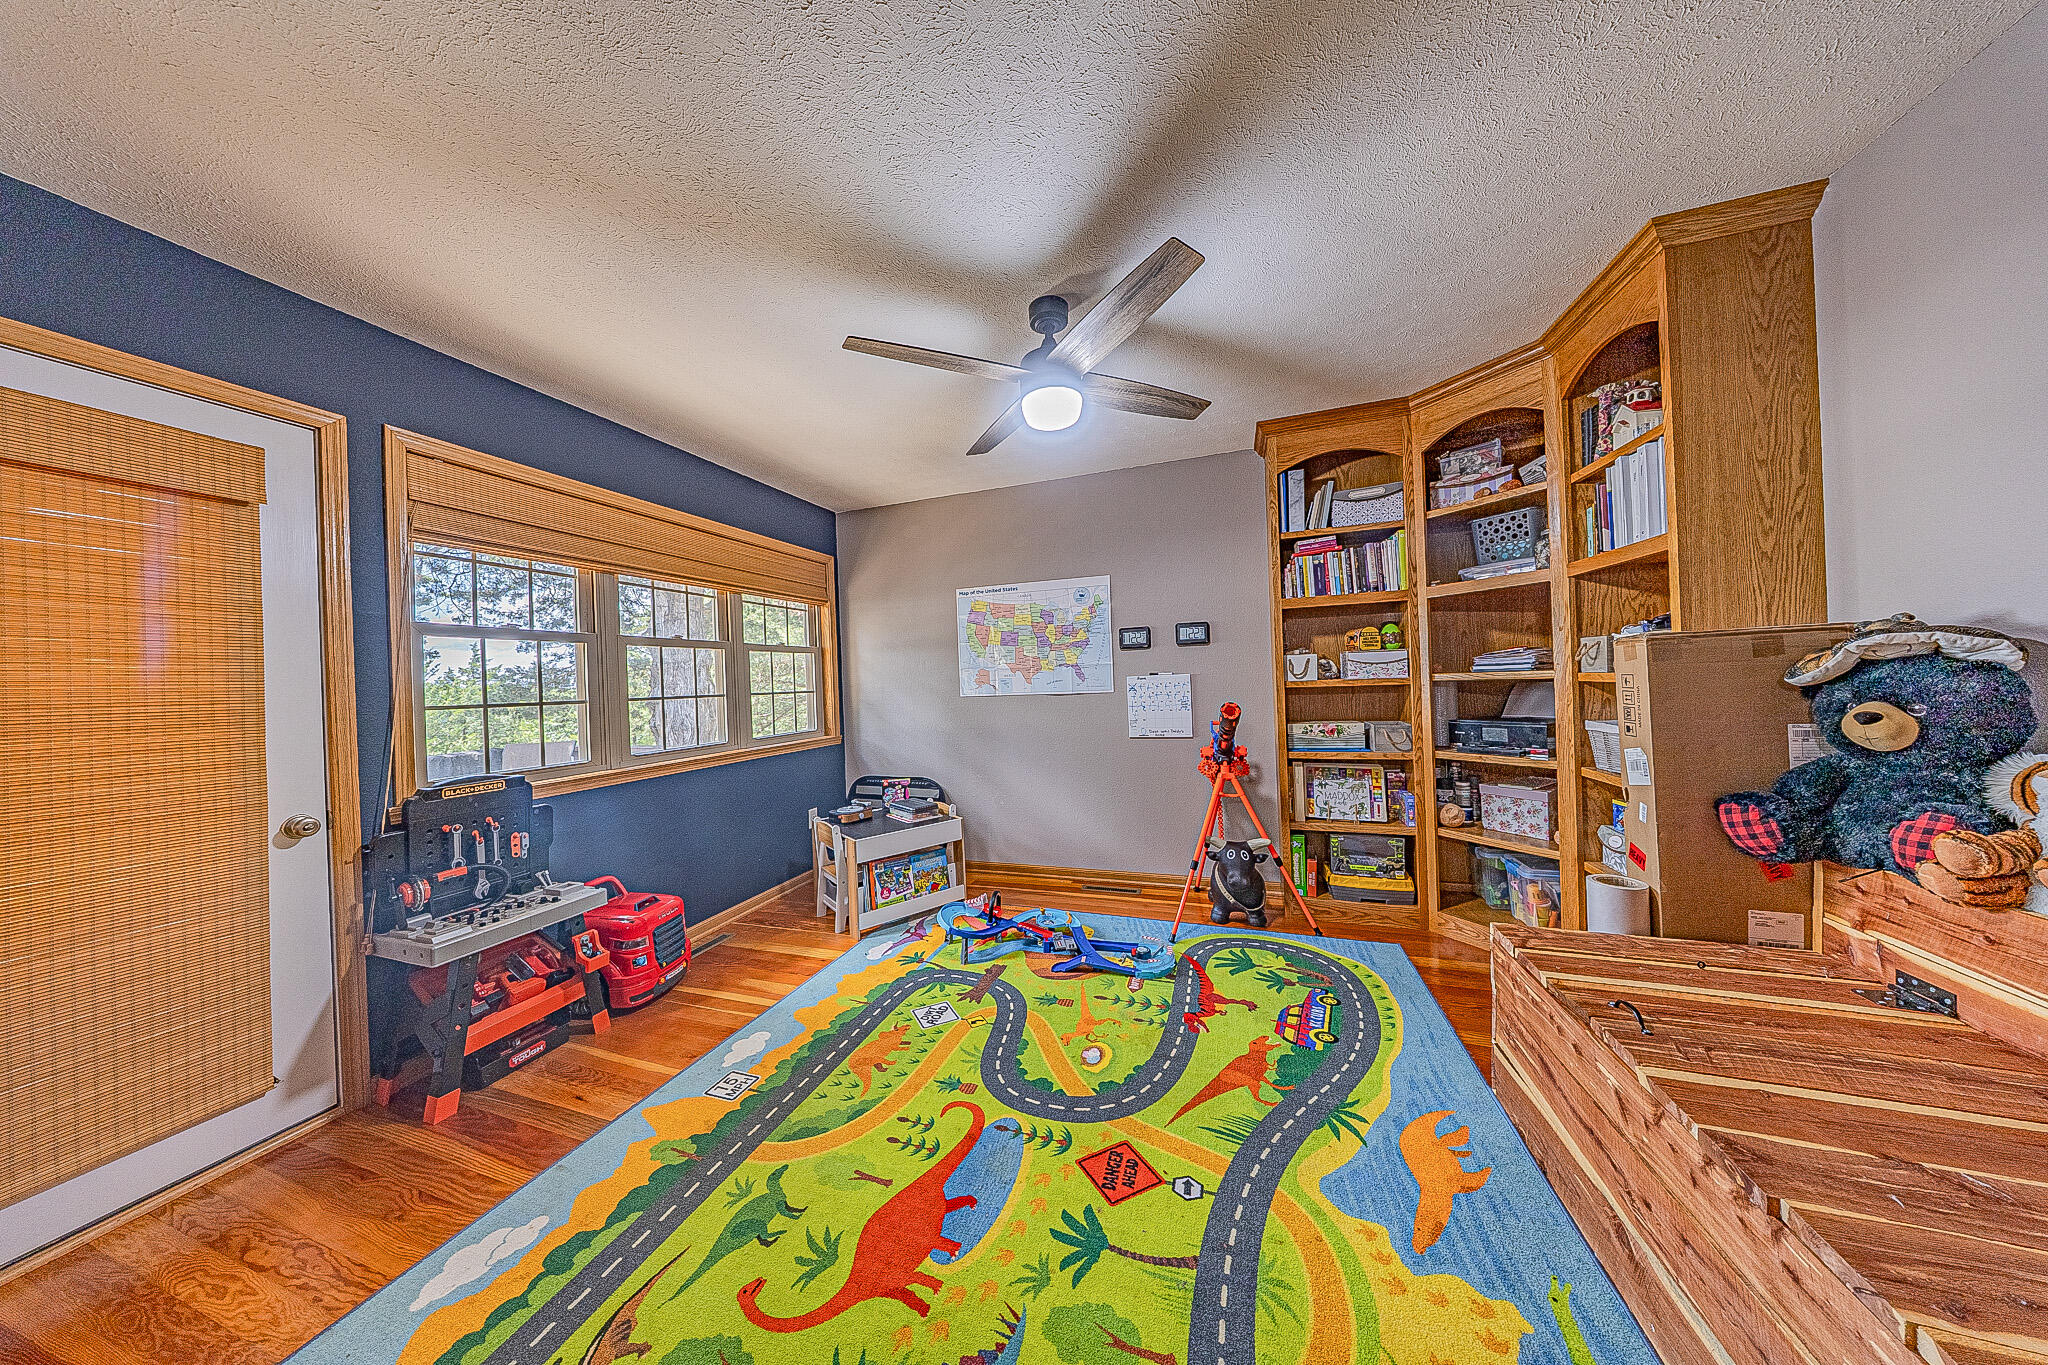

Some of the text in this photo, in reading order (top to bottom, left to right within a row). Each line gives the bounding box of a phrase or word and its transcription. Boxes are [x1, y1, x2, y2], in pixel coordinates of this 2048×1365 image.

[445, 783, 503, 797] BLACK+DECKER
[1324, 791, 1361, 801] MADDOX
[1629, 847, 1645, 868] HEAVY
[920, 1006, 937, 1021] DIRT
[926, 1005, 949, 1026] ROAD
[513, 1044, 544, 1065] TOUGH
[713, 1077, 739, 1091] 15
[724, 1077, 753, 1097] MPH
[1101, 1150, 1124, 1191] DANGER
[1121, 1158, 1139, 1190] AHEAD
